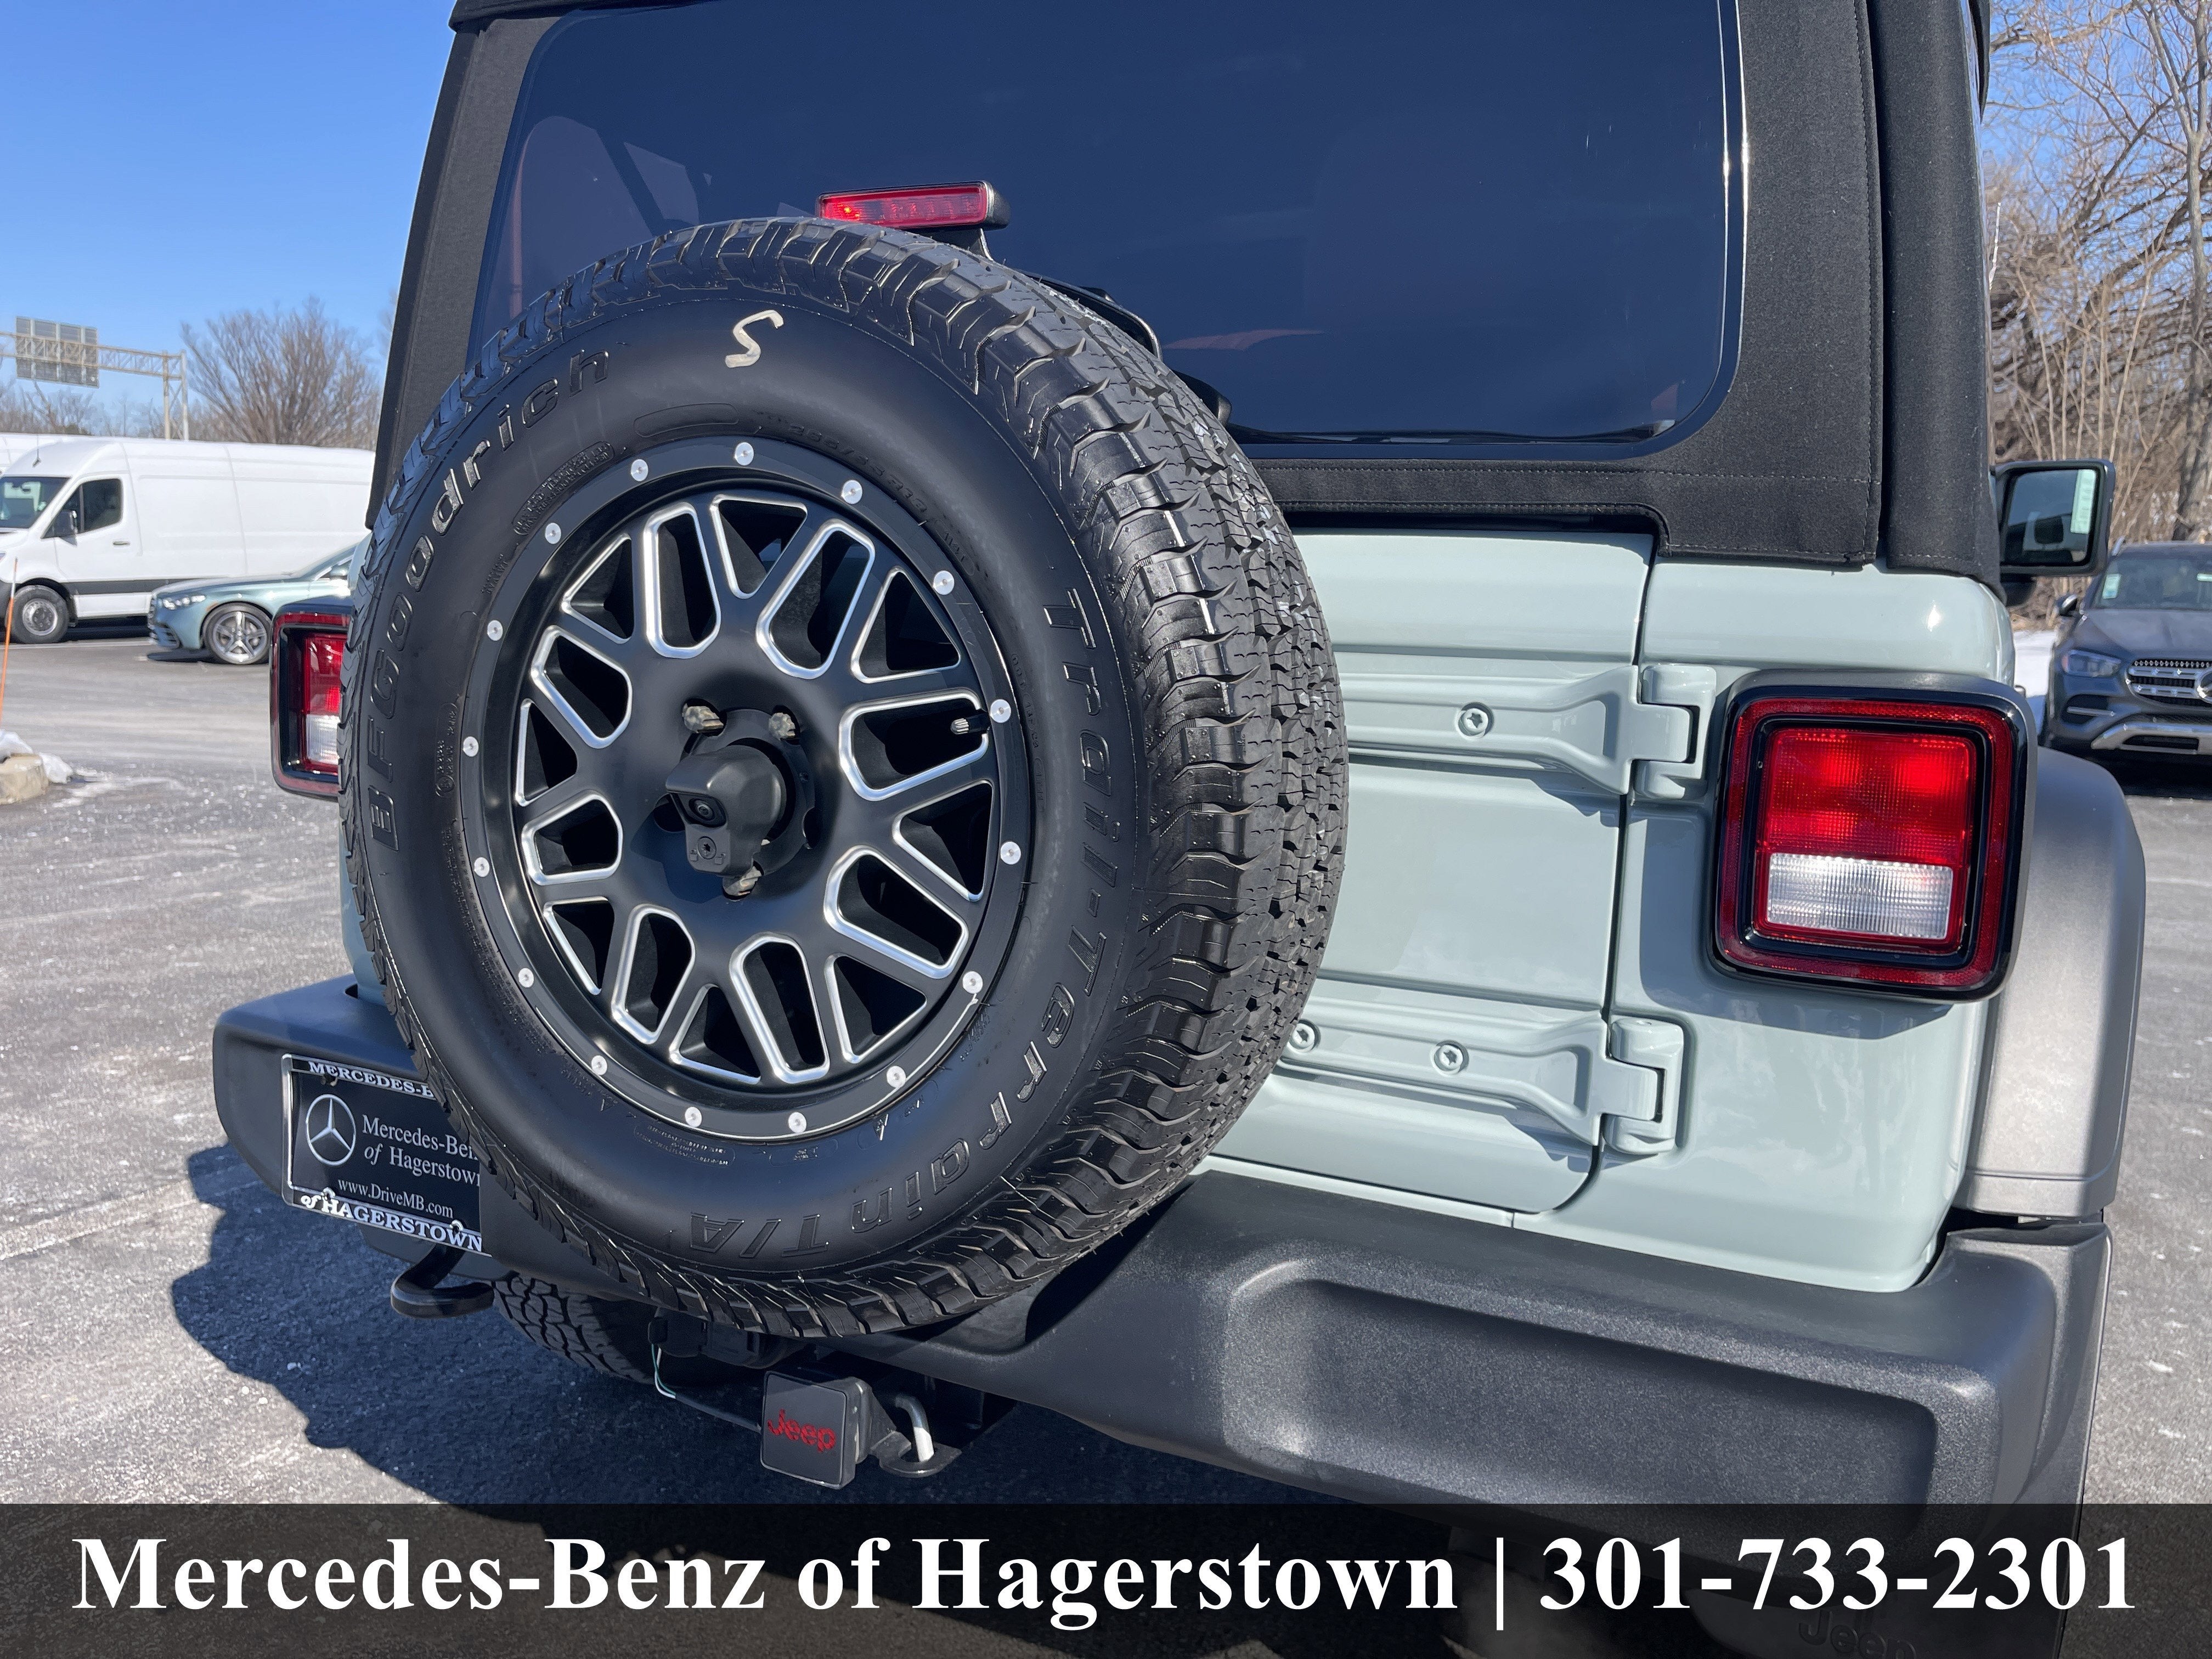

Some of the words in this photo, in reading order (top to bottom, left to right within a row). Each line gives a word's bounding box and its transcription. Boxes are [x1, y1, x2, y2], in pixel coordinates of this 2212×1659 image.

[366, 349, 610, 851] BFGoodrich
[364, 1143, 383, 1165] of
[338, 1178, 454, 1219] www.DriveMB.com
[301, 1195, 321, 1209] of
[321, 1197, 482, 1252] HAGERSTOWN
[690, 1211, 829, 1259] T/A
[767, 1408, 836, 1453] Jeep
